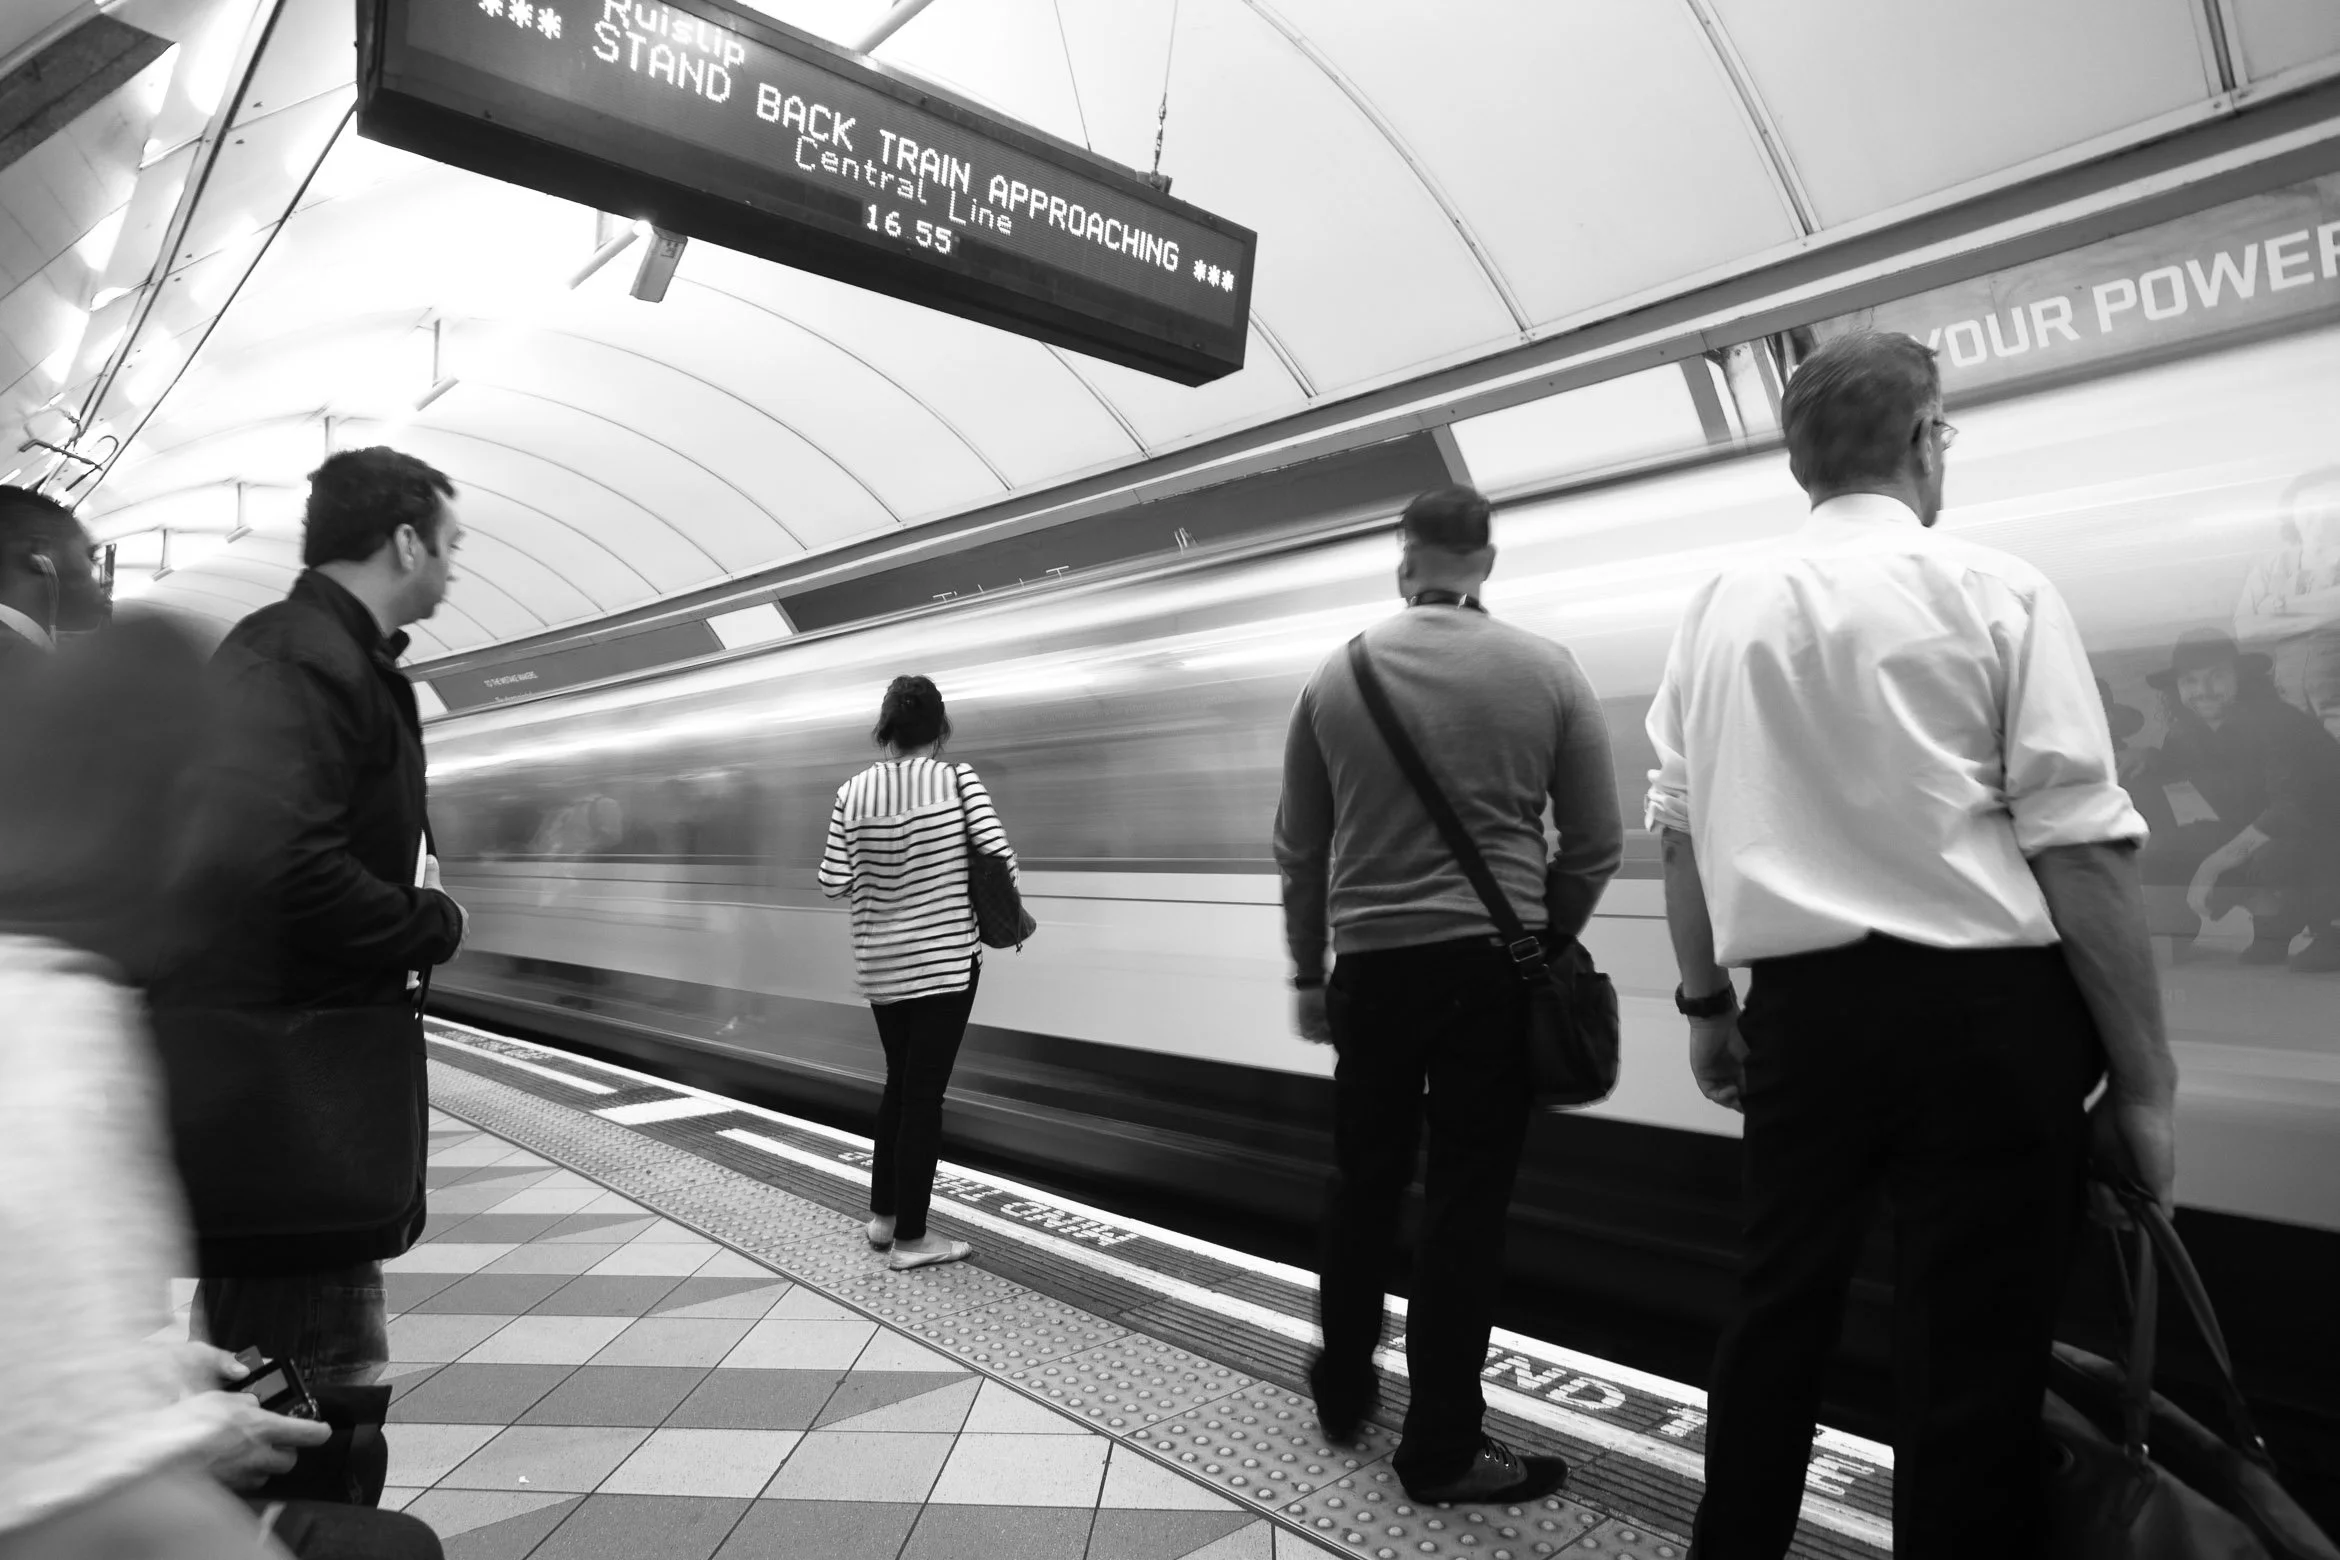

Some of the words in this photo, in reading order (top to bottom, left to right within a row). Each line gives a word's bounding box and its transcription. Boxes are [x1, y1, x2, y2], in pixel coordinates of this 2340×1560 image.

[603, 0, 745, 68] Ruislip
[592, 22, 731, 102] STAND
[756, 81, 856, 151] BACK
[880, 129, 971, 194] TRAIN
[988, 174, 1180, 272] APPROACHING
[795, 135, 927, 206] Central
[948, 190, 1013, 236] Line
[1000, 1201, 1140, 1248] MIND
